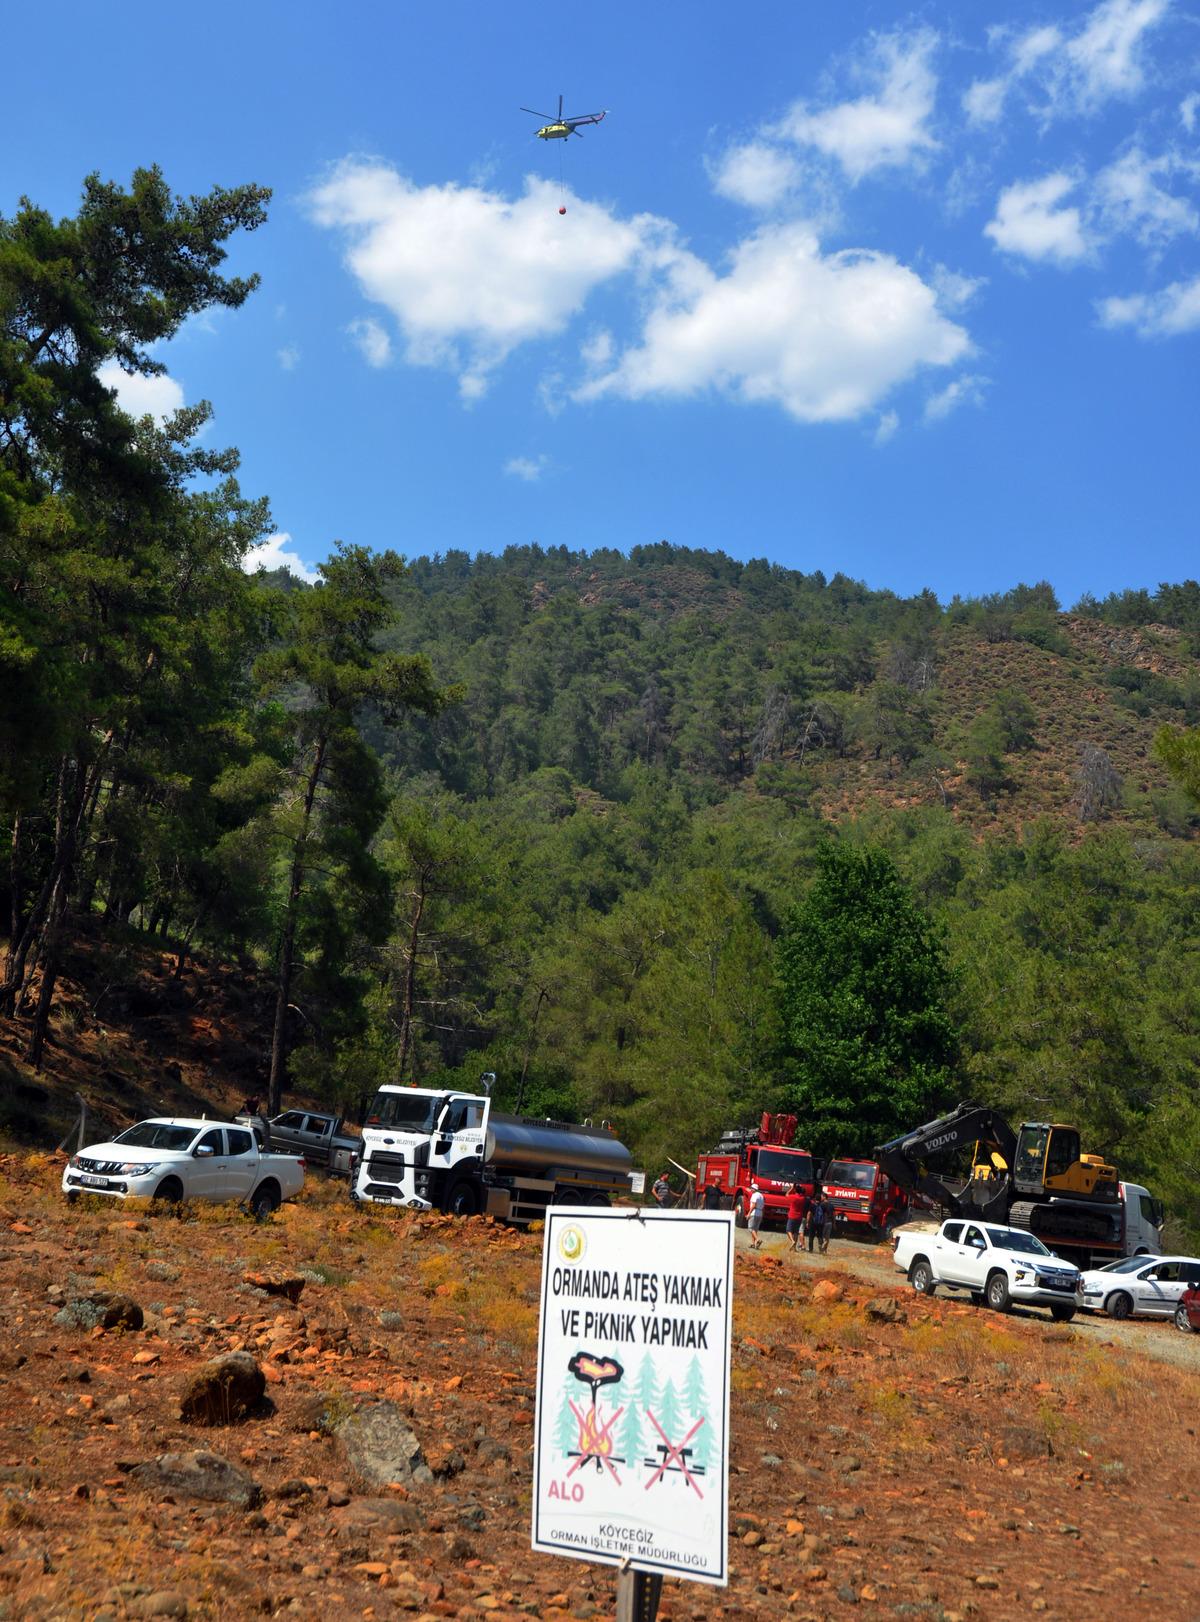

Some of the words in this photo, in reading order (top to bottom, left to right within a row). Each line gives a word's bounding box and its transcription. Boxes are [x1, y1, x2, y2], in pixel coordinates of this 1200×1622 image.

[925, 1131, 957, 1149] VOLVO
[553, 1267, 619, 1300] ORMANDA
[623, 1272, 658, 1312] ATEŞ
[663, 1274, 722, 1308] YAKMAK
[561, 1309, 580, 1337] VE
[641, 1315, 709, 1350] YAPMAK
[548, 1480, 584, 1503] ALO
[550, 1529, 588, 1545] ORMAN
[590, 1536, 634, 1554] İŞLETME
[599, 1524, 654, 1545] KÖYCEĞİZ
